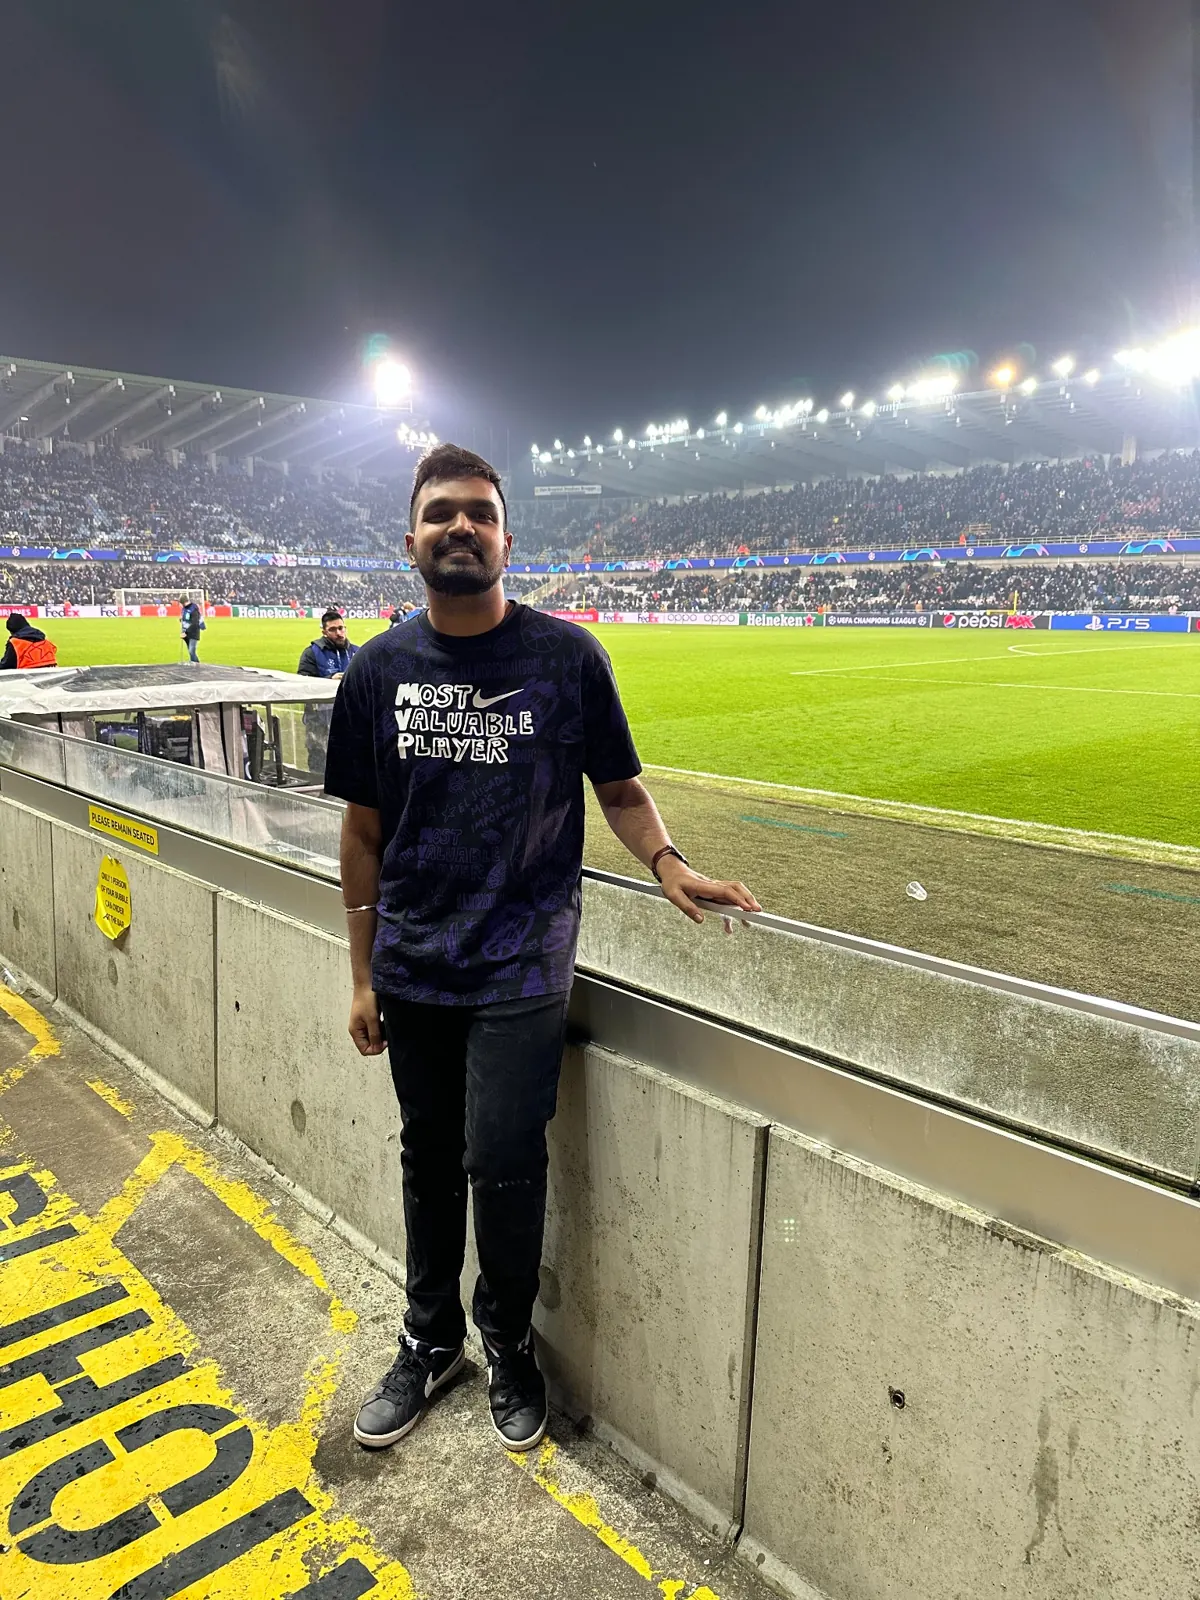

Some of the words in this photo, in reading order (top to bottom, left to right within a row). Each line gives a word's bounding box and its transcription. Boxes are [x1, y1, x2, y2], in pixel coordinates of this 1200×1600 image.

[238, 607, 297, 619] Heineken
[348, 607, 379, 619] pepsi
[746, 612, 803, 627] Heineken
[837, 616, 853, 625] UEFA
[853, 616, 891, 625] CHAMPIONS
[891, 616, 917, 625] LEAGUE
[958, 614, 1002, 629] pepsi
[1004, 614, 1036, 629] MAX
[1107, 618, 1151, 630] PS5
[394, 682, 474, 710] MOST
[394, 707, 534, 737] VALUABLE
[396, 732, 509, 764] PLAYER
[91, 812, 111, 828] PLEASE
[111, 819, 132, 836] REMAIN
[132, 828, 155, 846] SEATED
